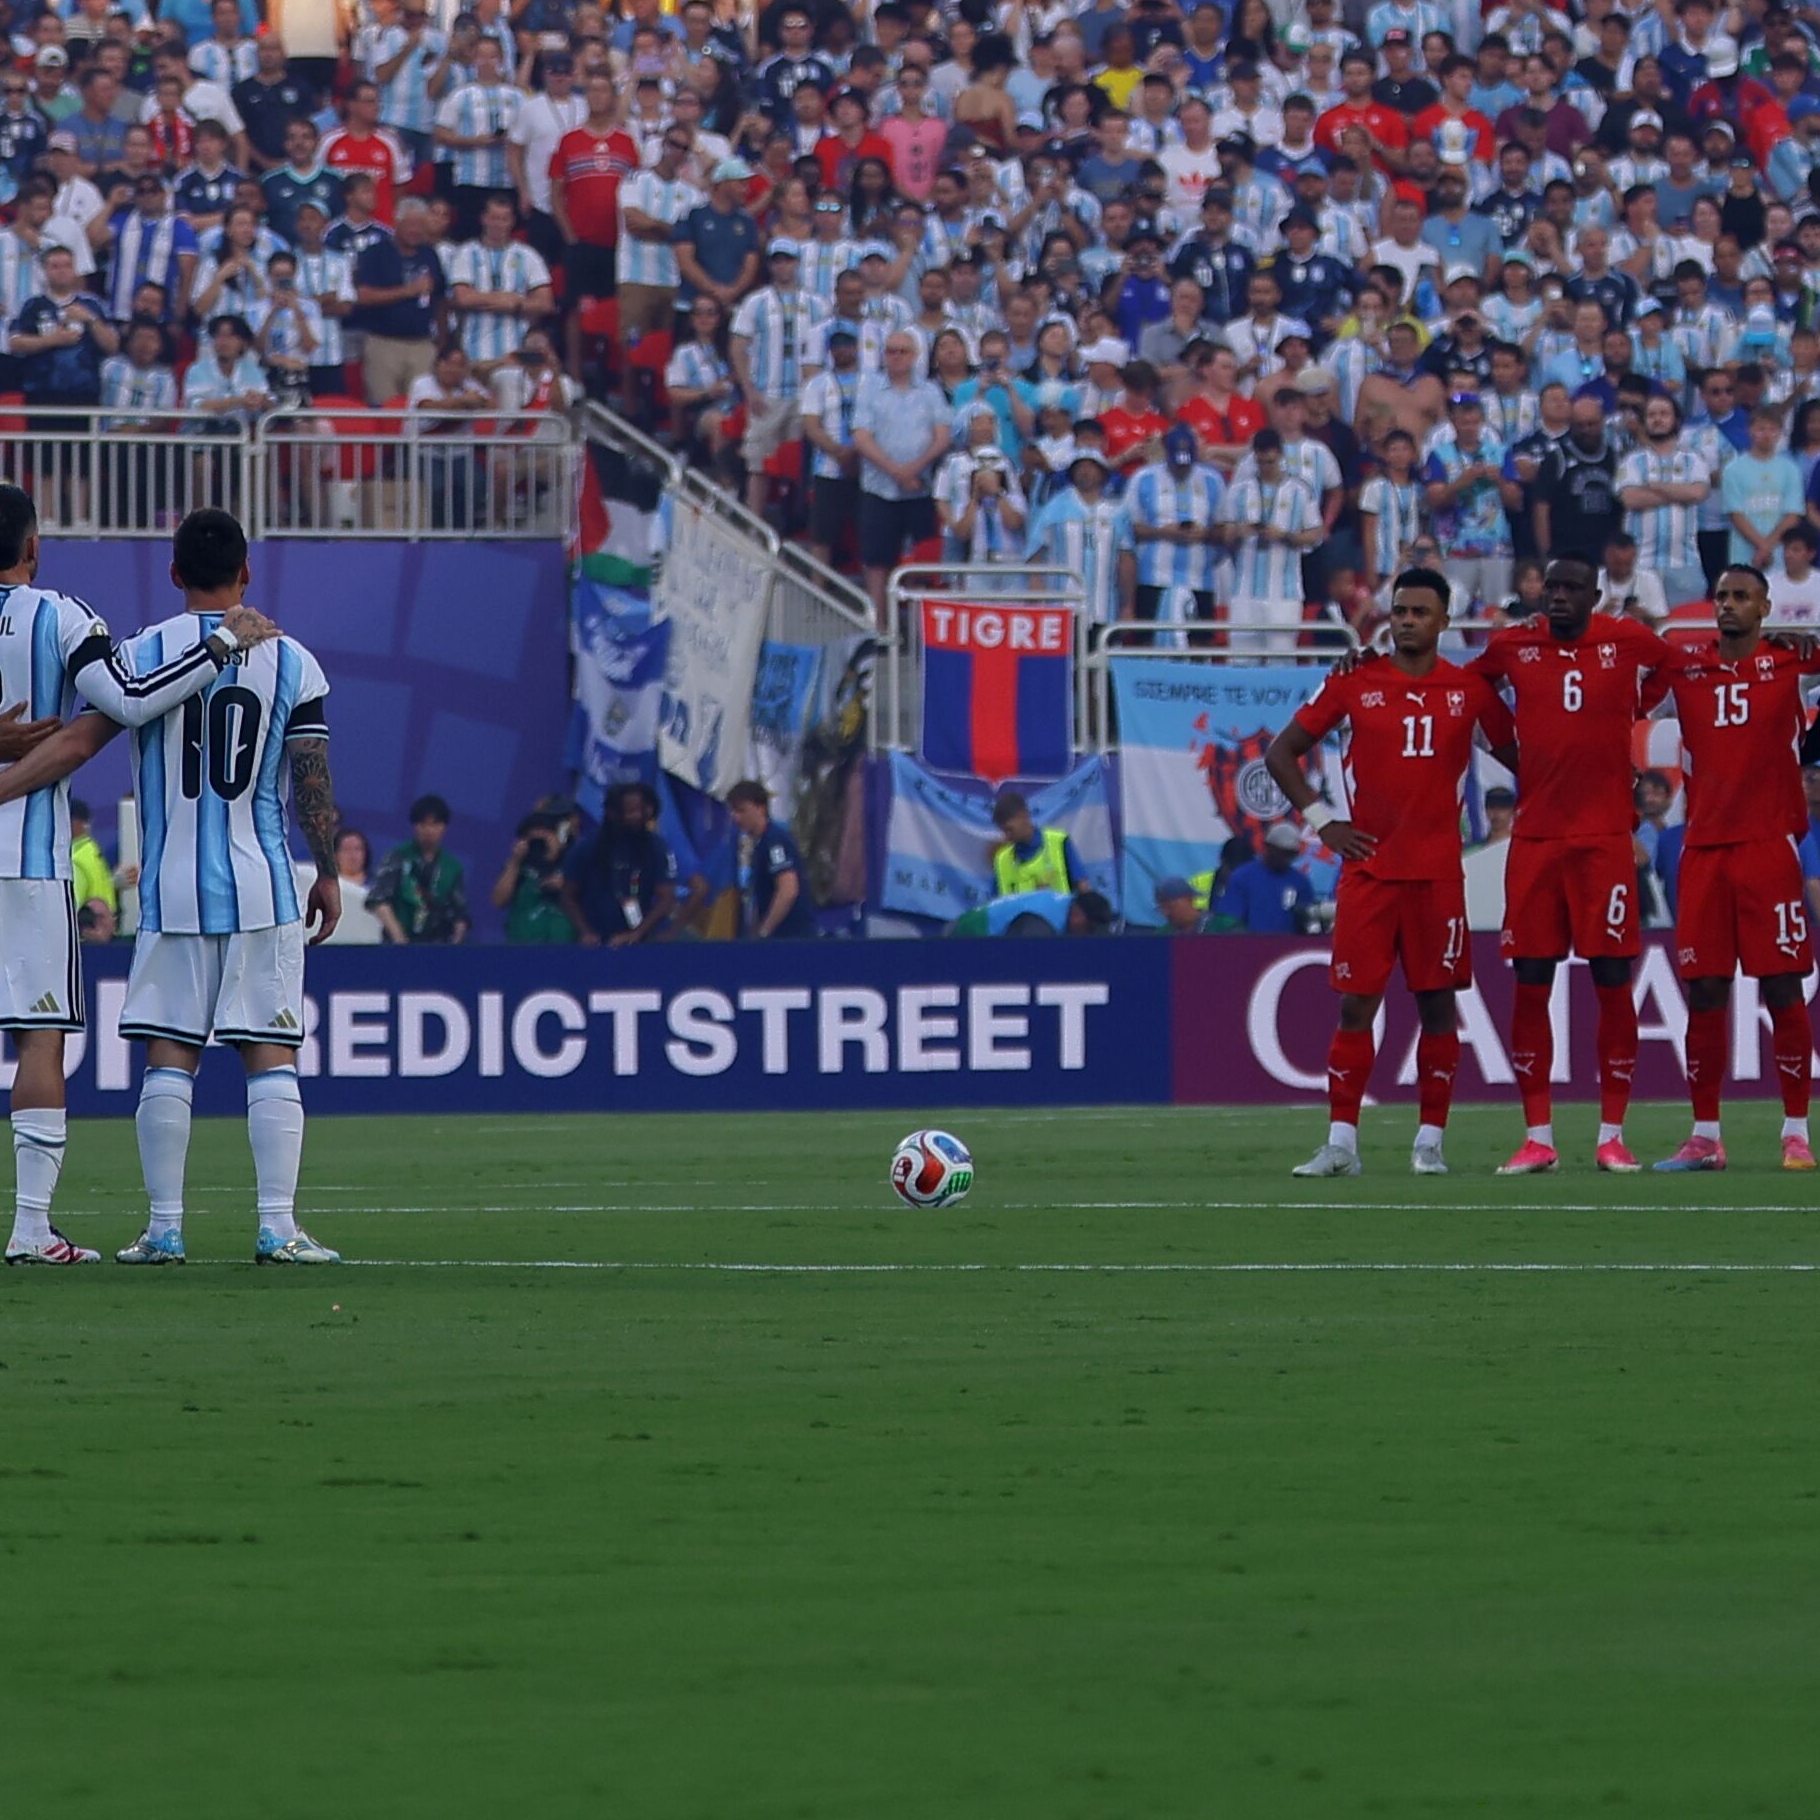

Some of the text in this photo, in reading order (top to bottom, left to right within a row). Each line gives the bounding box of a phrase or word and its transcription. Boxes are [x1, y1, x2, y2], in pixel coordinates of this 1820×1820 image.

[932, 605, 1064, 654] TIGRE
[1133, 679, 1217, 704] SIEMPRE
[1223, 684, 1247, 706] TE
[1252, 686, 1291, 707] VOY
[1562, 669, 1584, 713] 6
[1713, 681, 1750, 728] 15
[180, 685, 262, 801] 10
[1401, 714, 1435, 758] 11
[1606, 883, 1628, 926] 6
[1773, 900, 1808, 946] 15
[1443, 916, 1466, 961] 11
